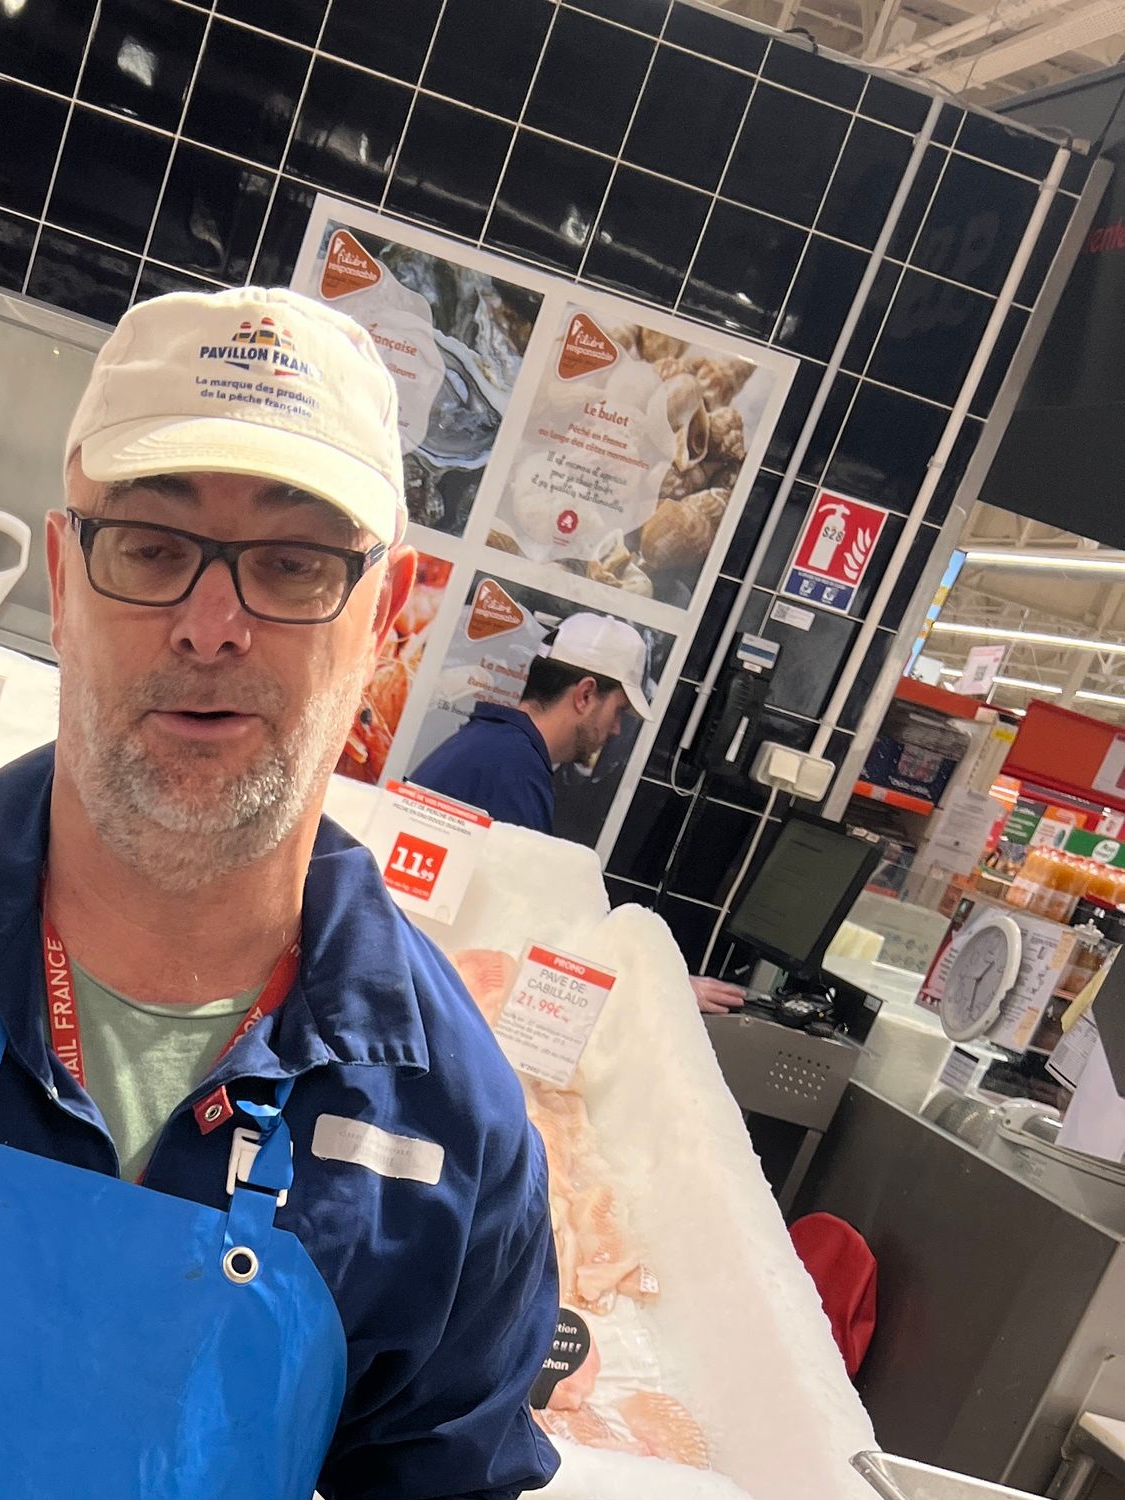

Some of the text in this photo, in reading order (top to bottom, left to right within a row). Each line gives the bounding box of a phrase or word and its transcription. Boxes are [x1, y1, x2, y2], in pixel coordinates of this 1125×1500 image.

[200, 346, 323, 382] PAVILLON FRAN
[196, 376, 207, 385] La
[210, 379, 253, 390] marque
[256, 382, 274, 394] des
[201, 389, 312, 418] de la pêche française
[584, 402, 629, 426] Le bulot
[822, 527, 844, 542] S28
[554, 957, 586, 975] PROMO
[47, 936, 75, 1030] FRANCE
[527, 978, 589, 1008] CABILLAUD
[540, 969, 586, 994] PAVE DE
